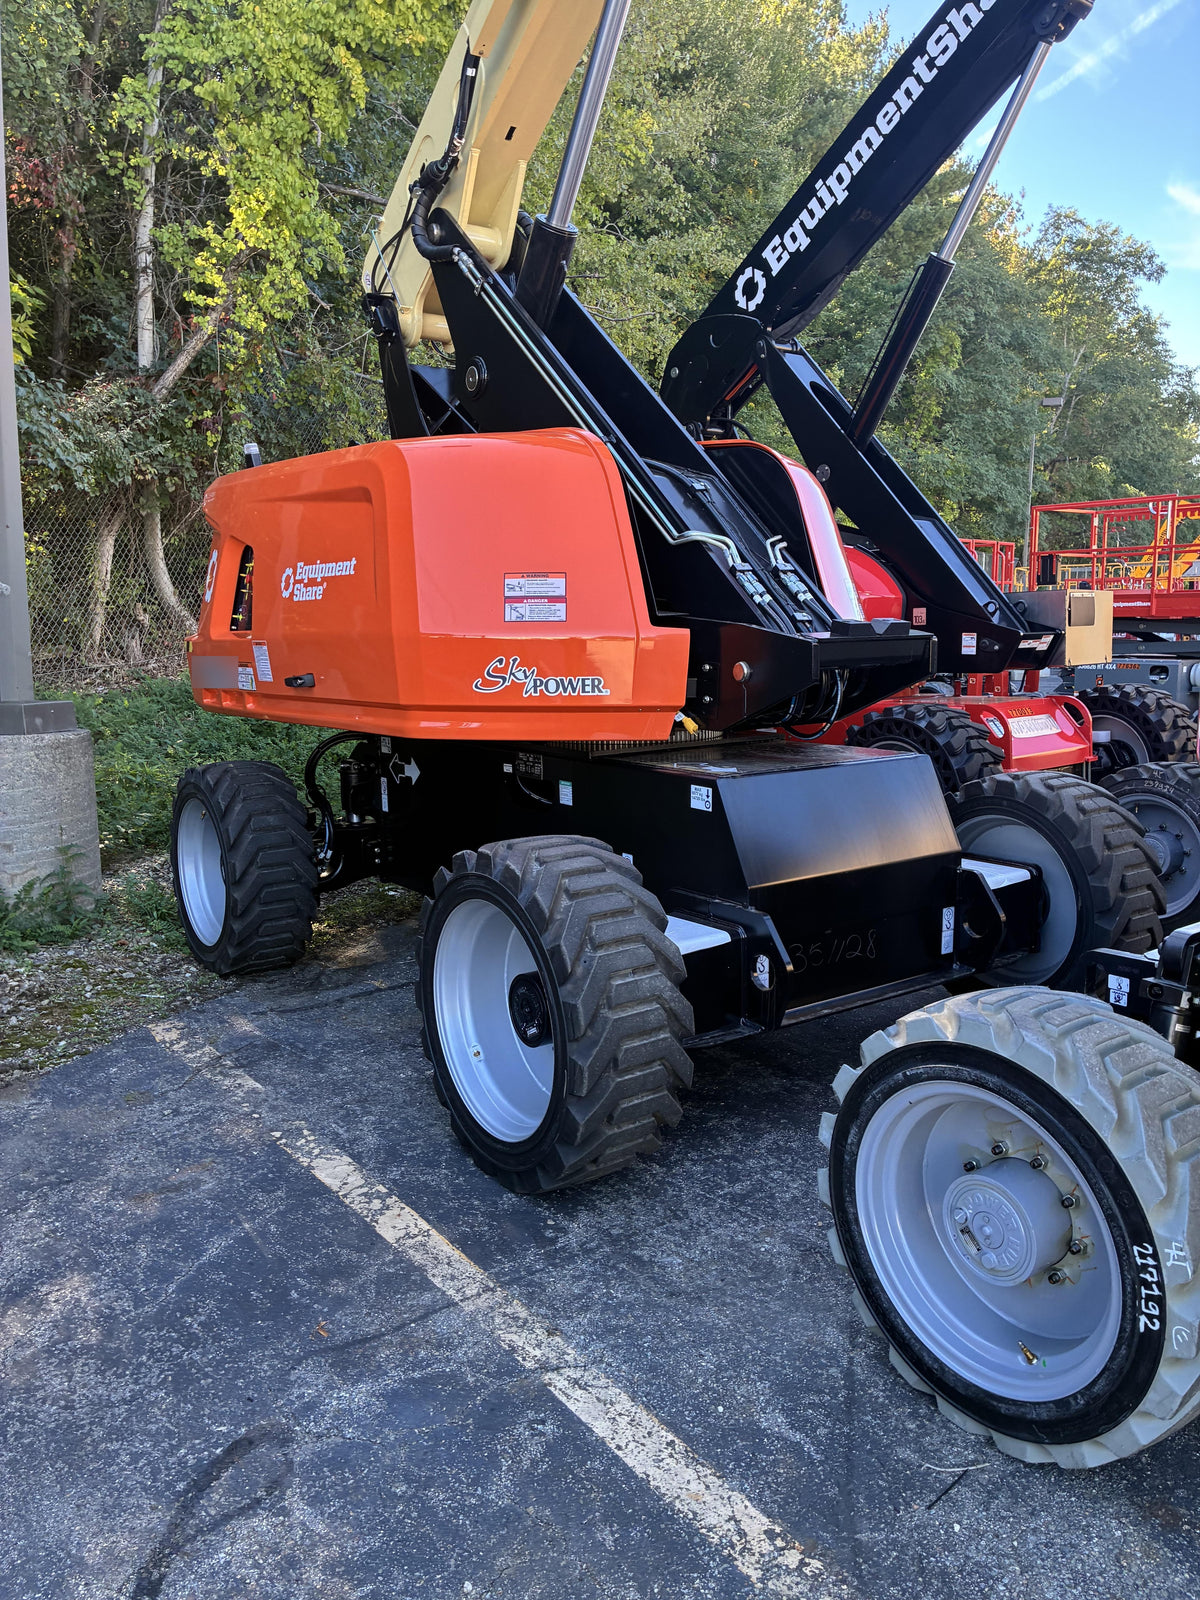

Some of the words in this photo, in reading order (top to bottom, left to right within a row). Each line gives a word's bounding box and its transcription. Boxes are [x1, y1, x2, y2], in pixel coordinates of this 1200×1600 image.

[295, 557, 357, 583] Equipment
[789, 928, 876, 974] 351128
[1132, 1242, 1163, 1333] 217192
